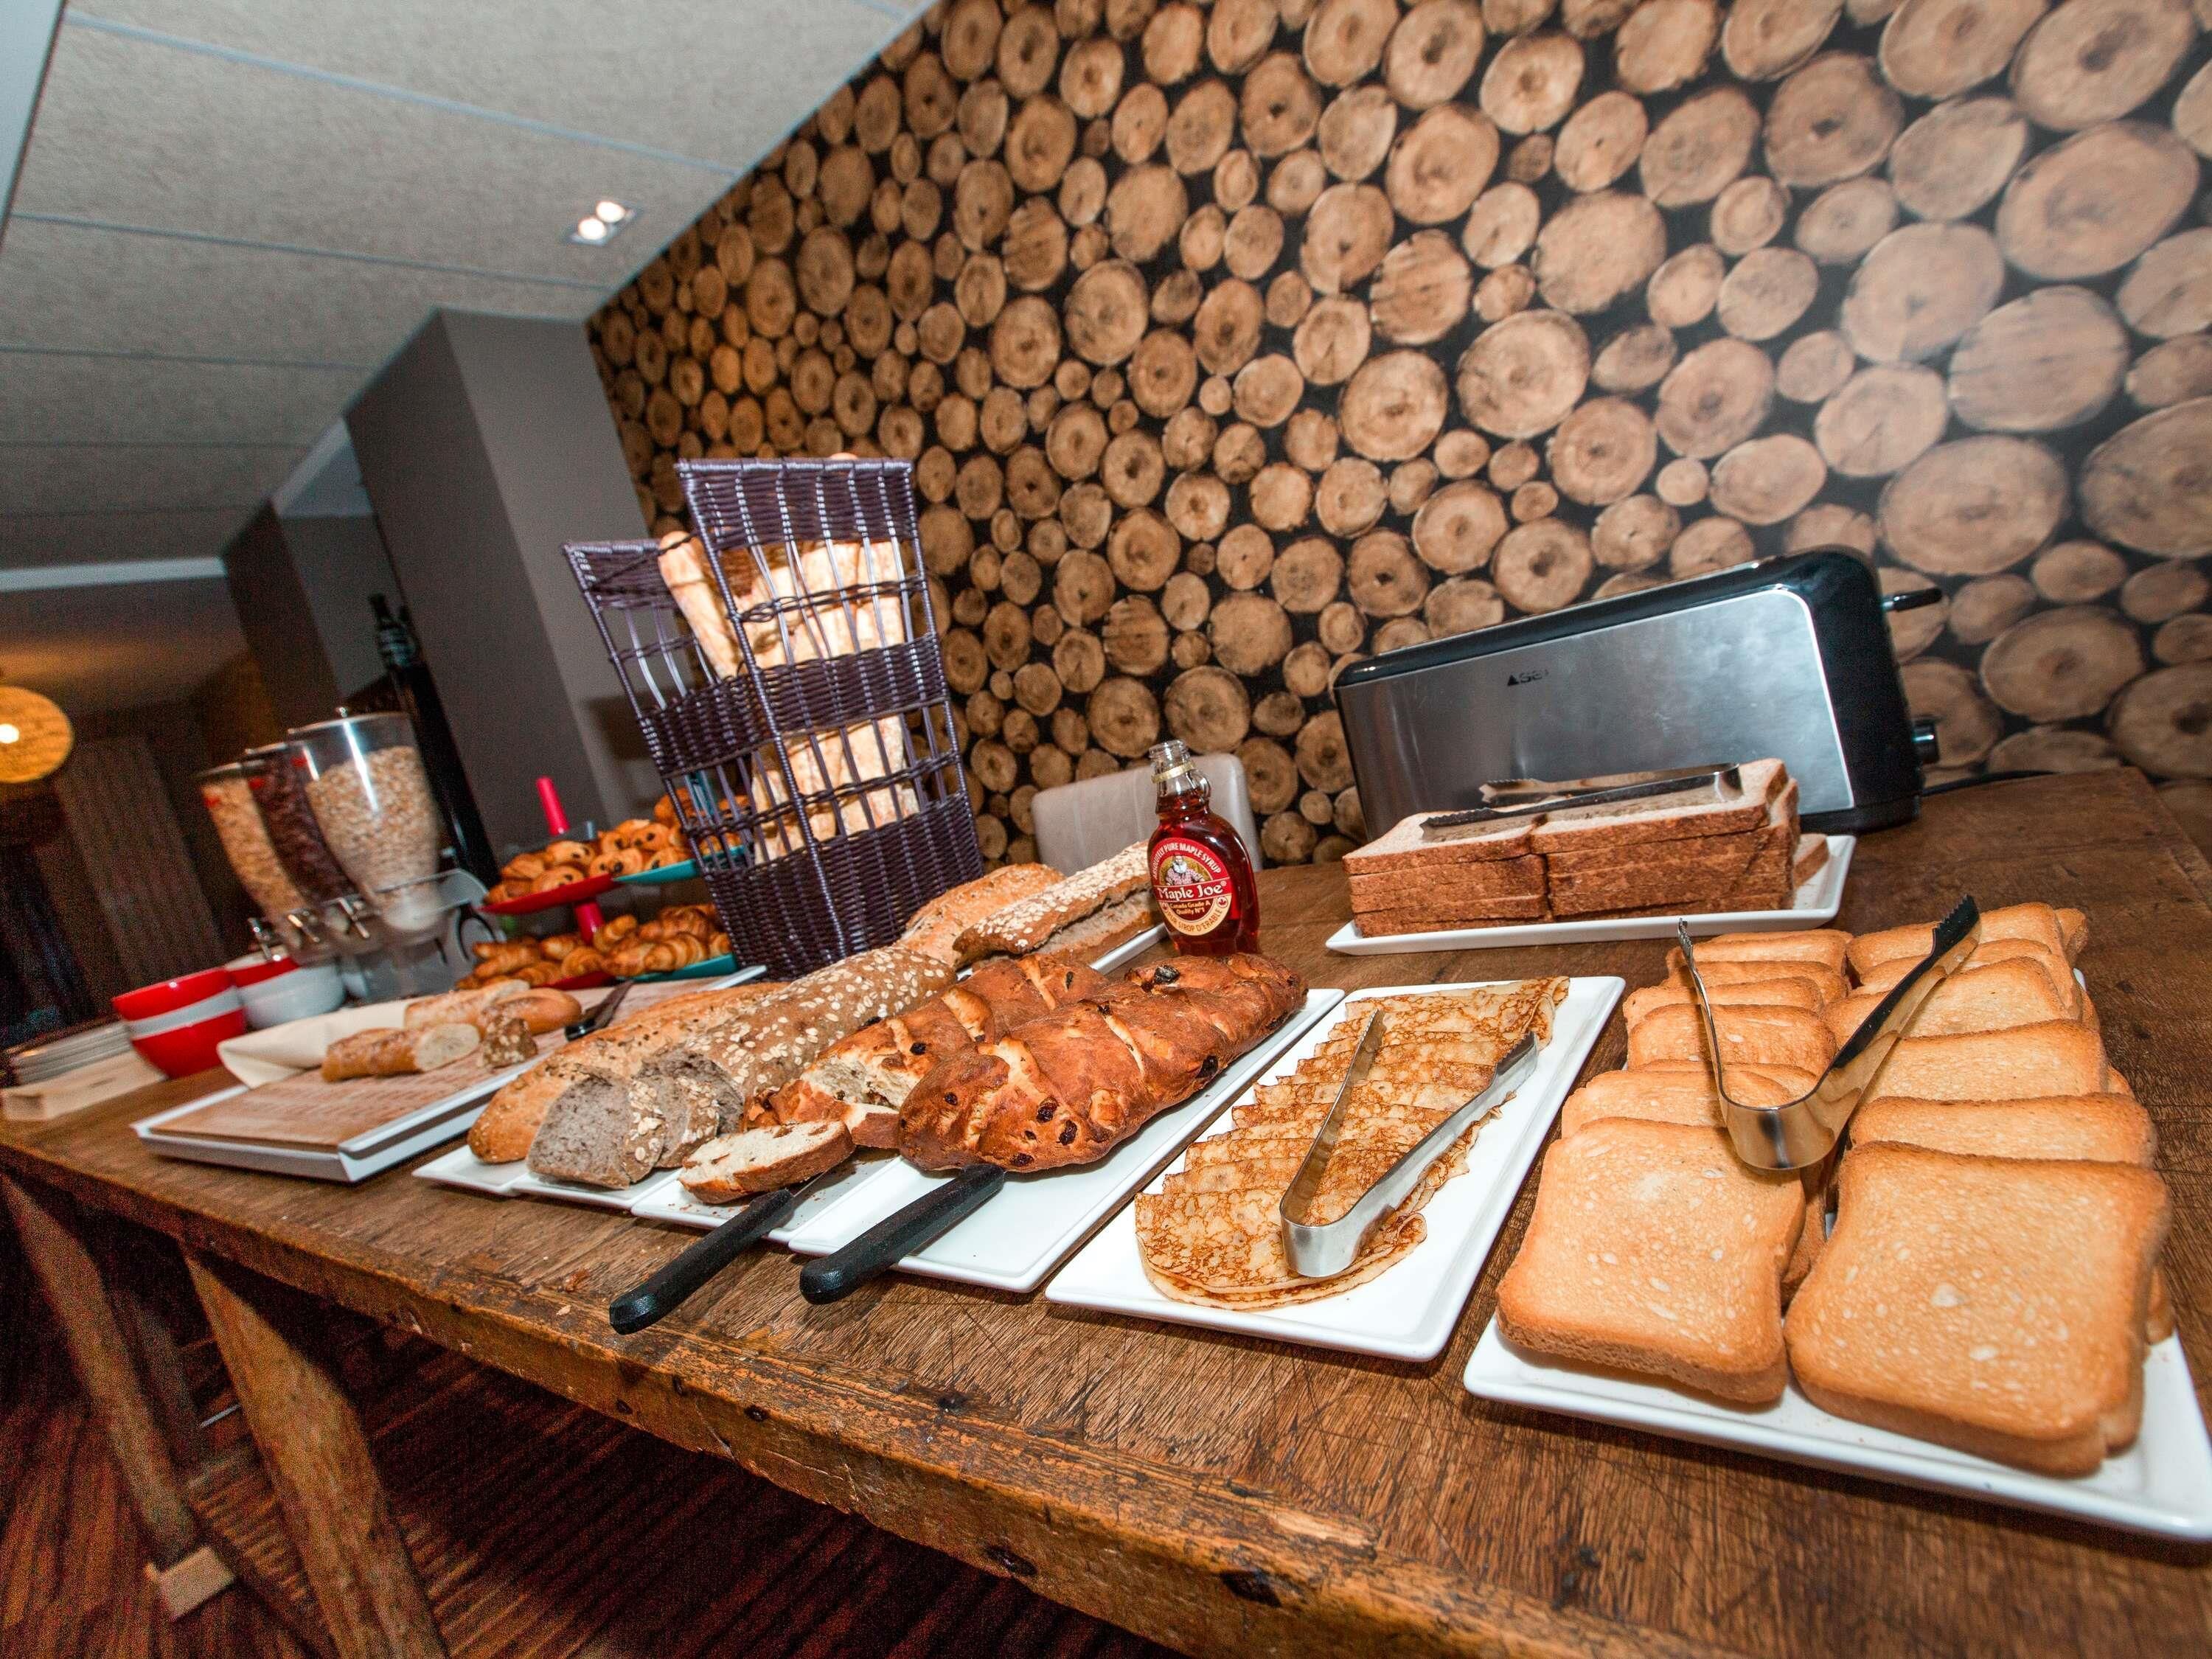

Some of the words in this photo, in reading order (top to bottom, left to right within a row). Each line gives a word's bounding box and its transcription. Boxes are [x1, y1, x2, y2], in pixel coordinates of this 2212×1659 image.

[1163, 842, 1179, 852] PURE
[1180, 844, 1203, 858] MAPLE
[1202, 853, 1222, 874] SYRUP
[1157, 887, 1194, 901] Maple
[1178, 921, 1195, 932] SIROP
